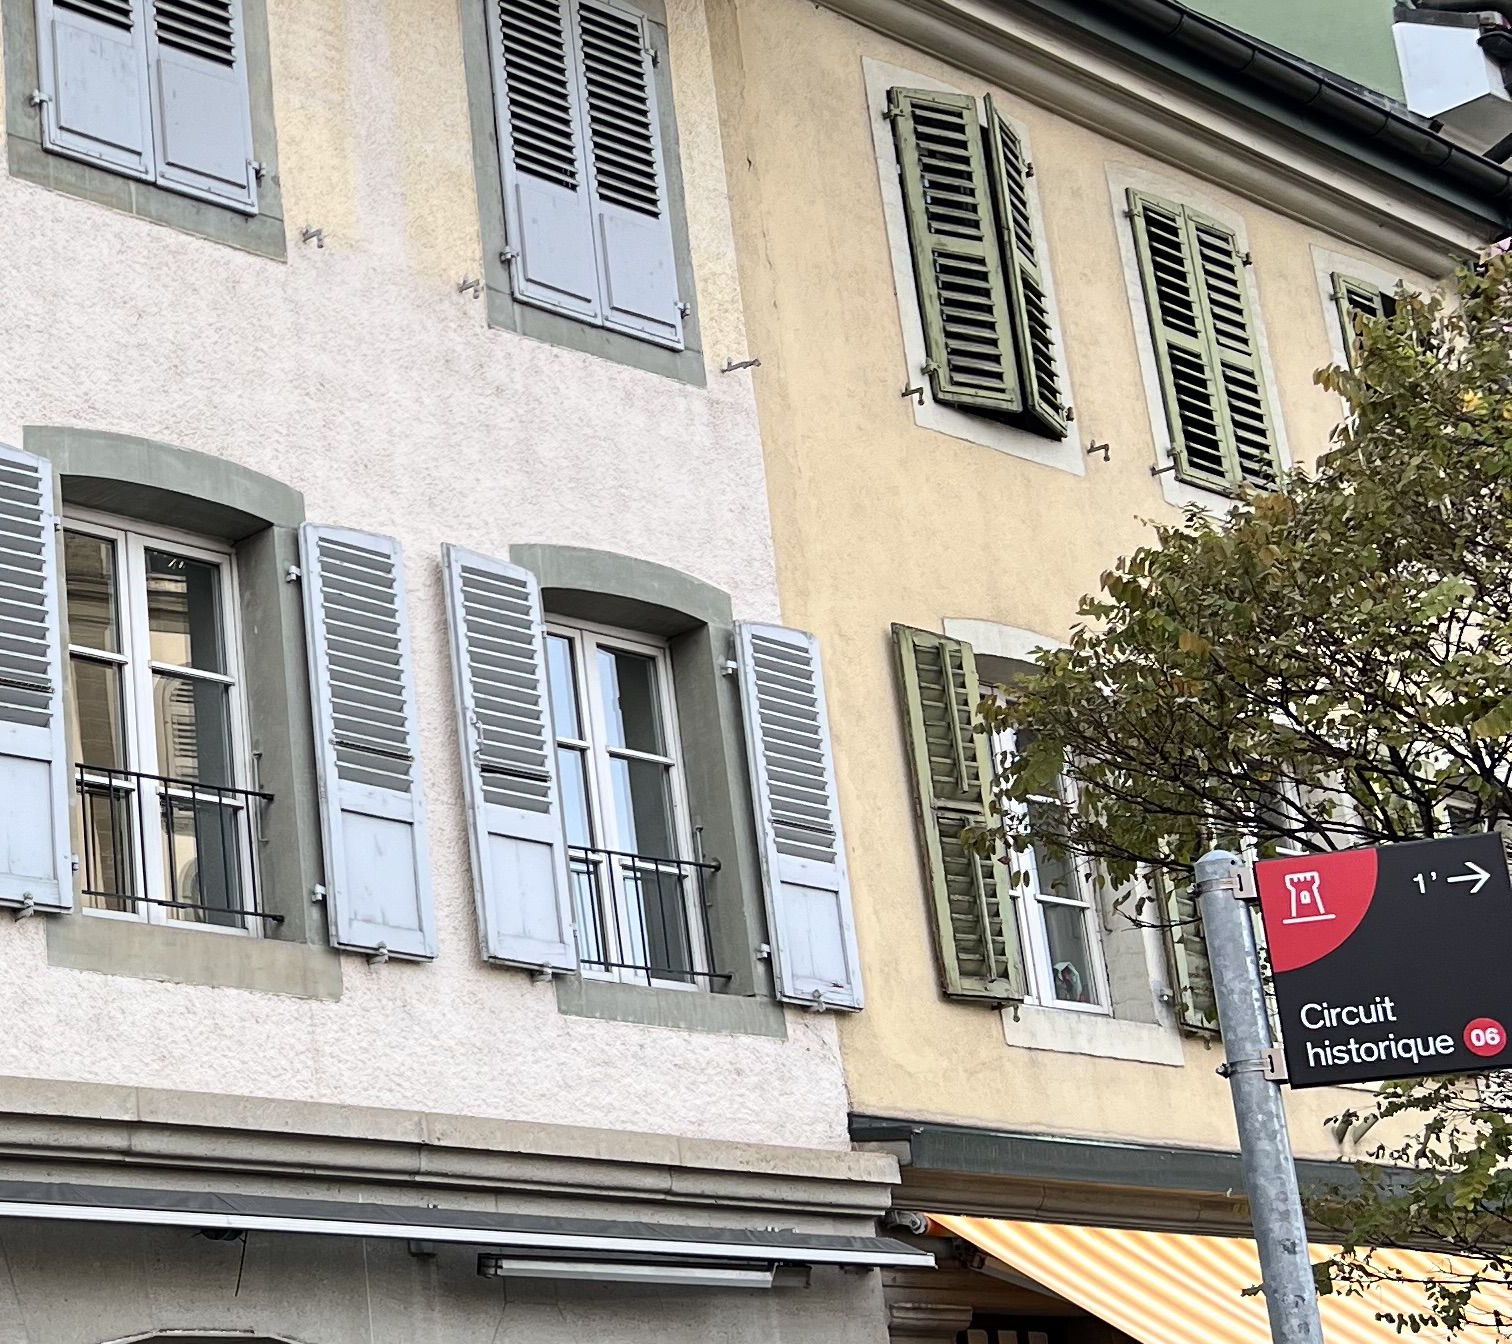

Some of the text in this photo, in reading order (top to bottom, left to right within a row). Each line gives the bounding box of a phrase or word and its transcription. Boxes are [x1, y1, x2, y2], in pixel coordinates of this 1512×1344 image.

[1300, 996, 1397, 1030] Circuit
[1306, 1027, 1501, 1067] historique 06
